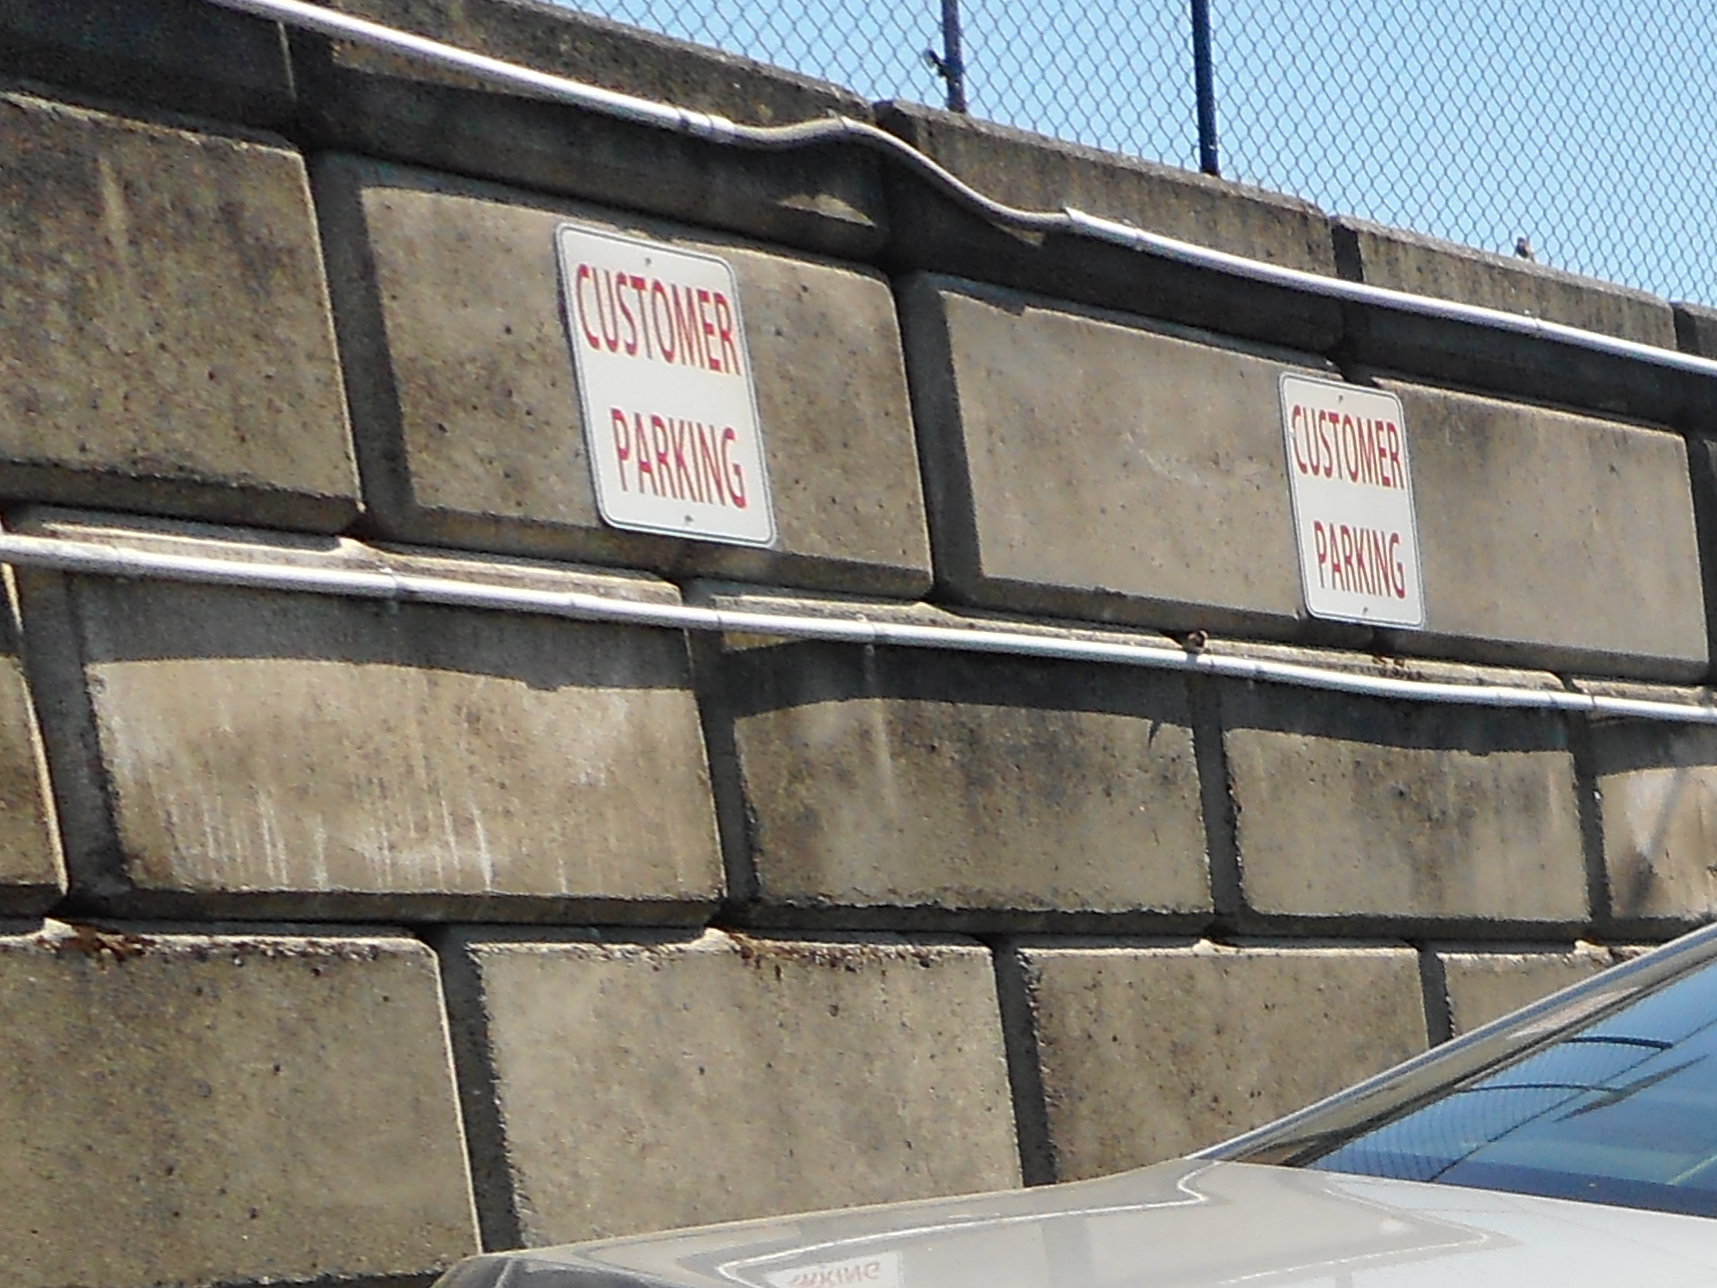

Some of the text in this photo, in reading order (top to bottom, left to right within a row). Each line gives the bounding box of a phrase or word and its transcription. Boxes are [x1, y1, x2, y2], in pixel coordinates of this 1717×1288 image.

[576, 264, 741, 376] CUSTOMER
[610, 407, 747, 509] PARKING
[1291, 404, 1405, 490] CUSTOMER
[1313, 520, 1406, 599] PARKING
